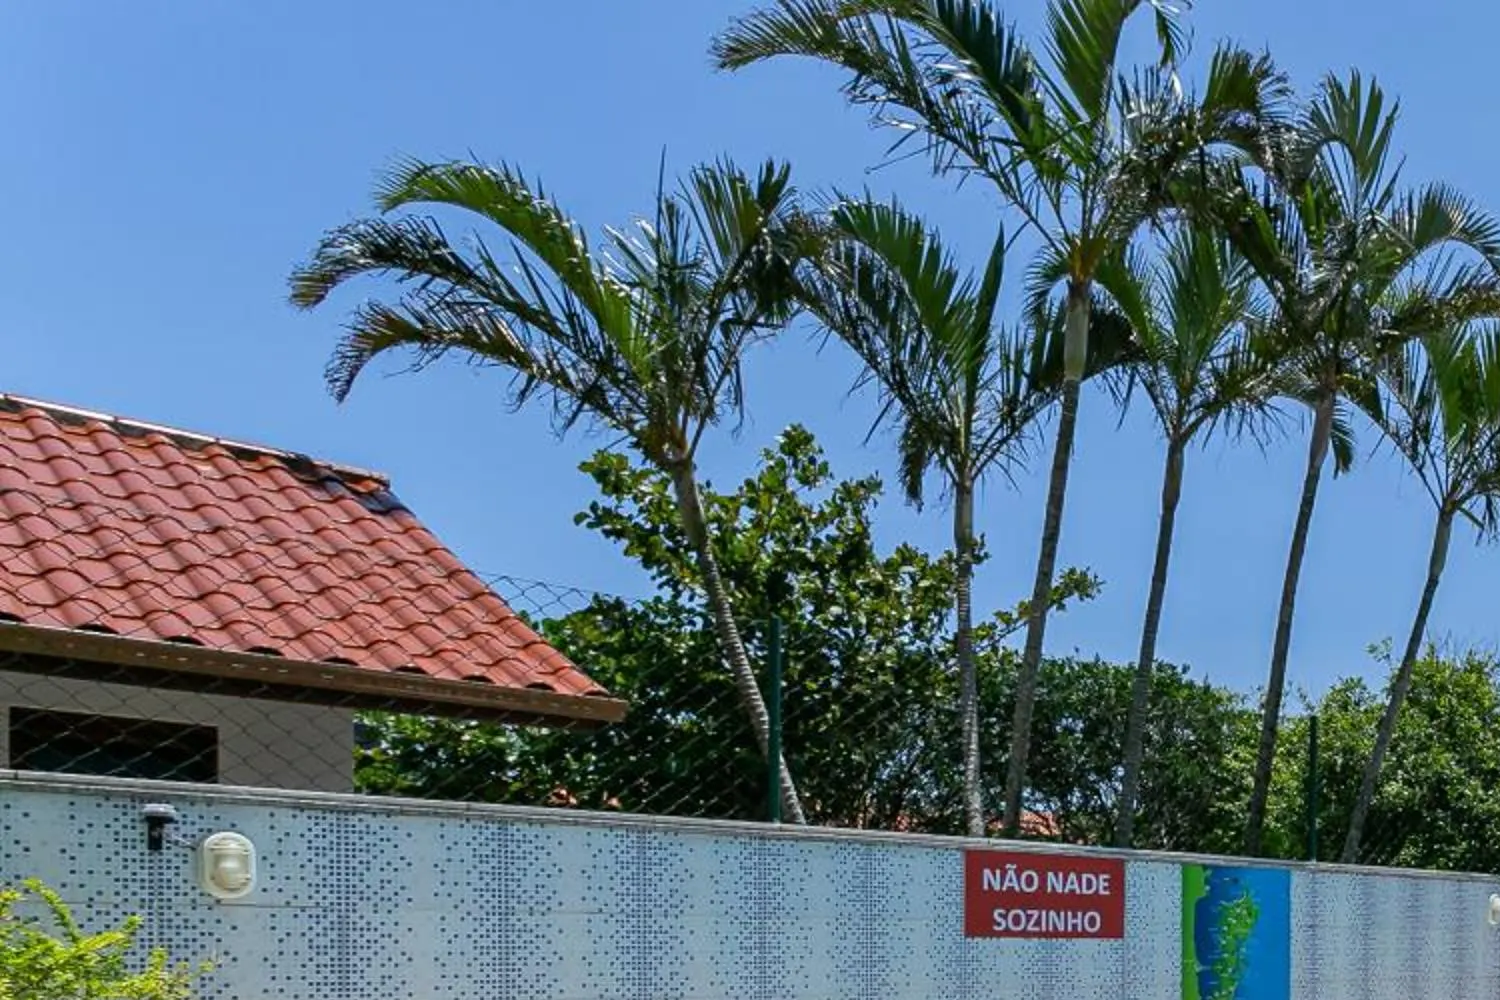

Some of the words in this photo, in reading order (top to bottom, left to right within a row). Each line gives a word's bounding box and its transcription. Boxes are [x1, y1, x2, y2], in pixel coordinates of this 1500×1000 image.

[983, 864, 1039, 893] NÃO
[1047, 871, 1111, 895] NADE
[993, 909, 1101, 933] SOZINHO
